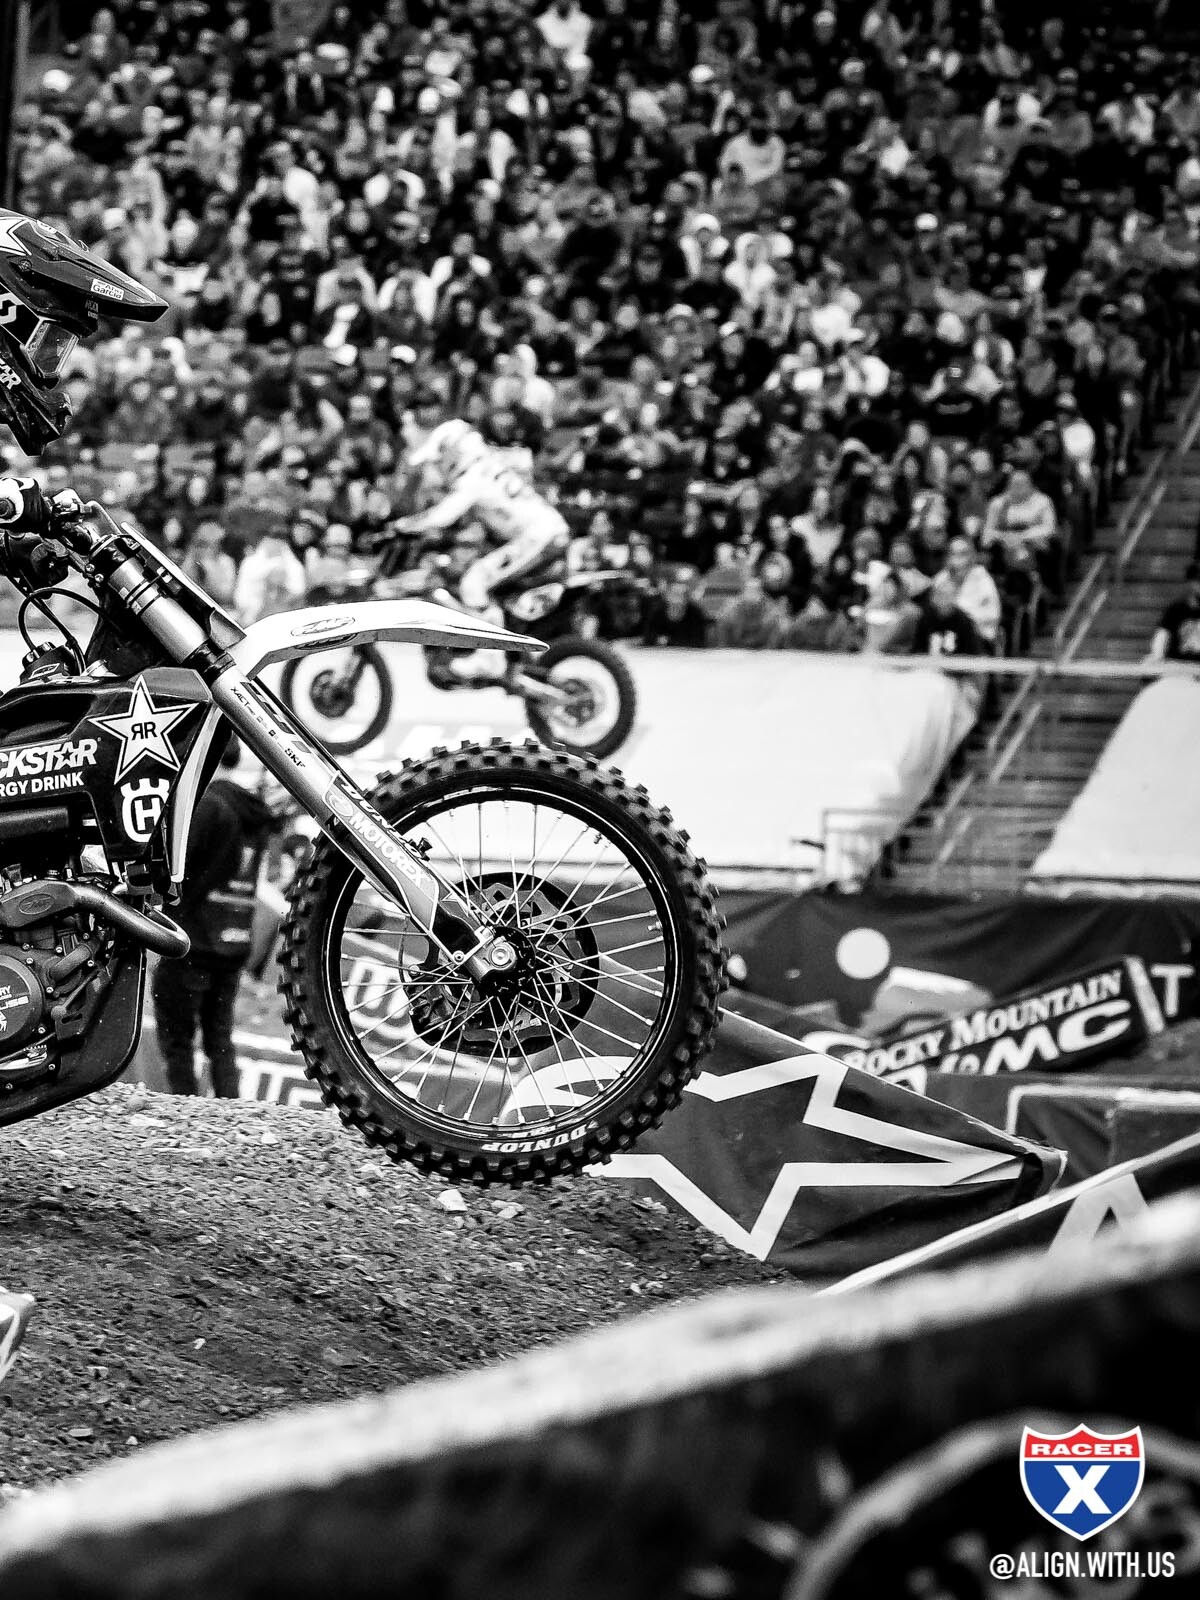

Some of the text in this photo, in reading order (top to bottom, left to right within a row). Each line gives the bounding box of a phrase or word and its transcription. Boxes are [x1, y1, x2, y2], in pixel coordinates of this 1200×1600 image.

[284, 748, 306, 767] SKF
[31, 771, 84, 793] DRINK
[349, 810, 431, 889] MOTOREX
[949, 970, 1122, 1050] MOUNTAIN
[480, 1123, 588, 1153] DUNLOP
